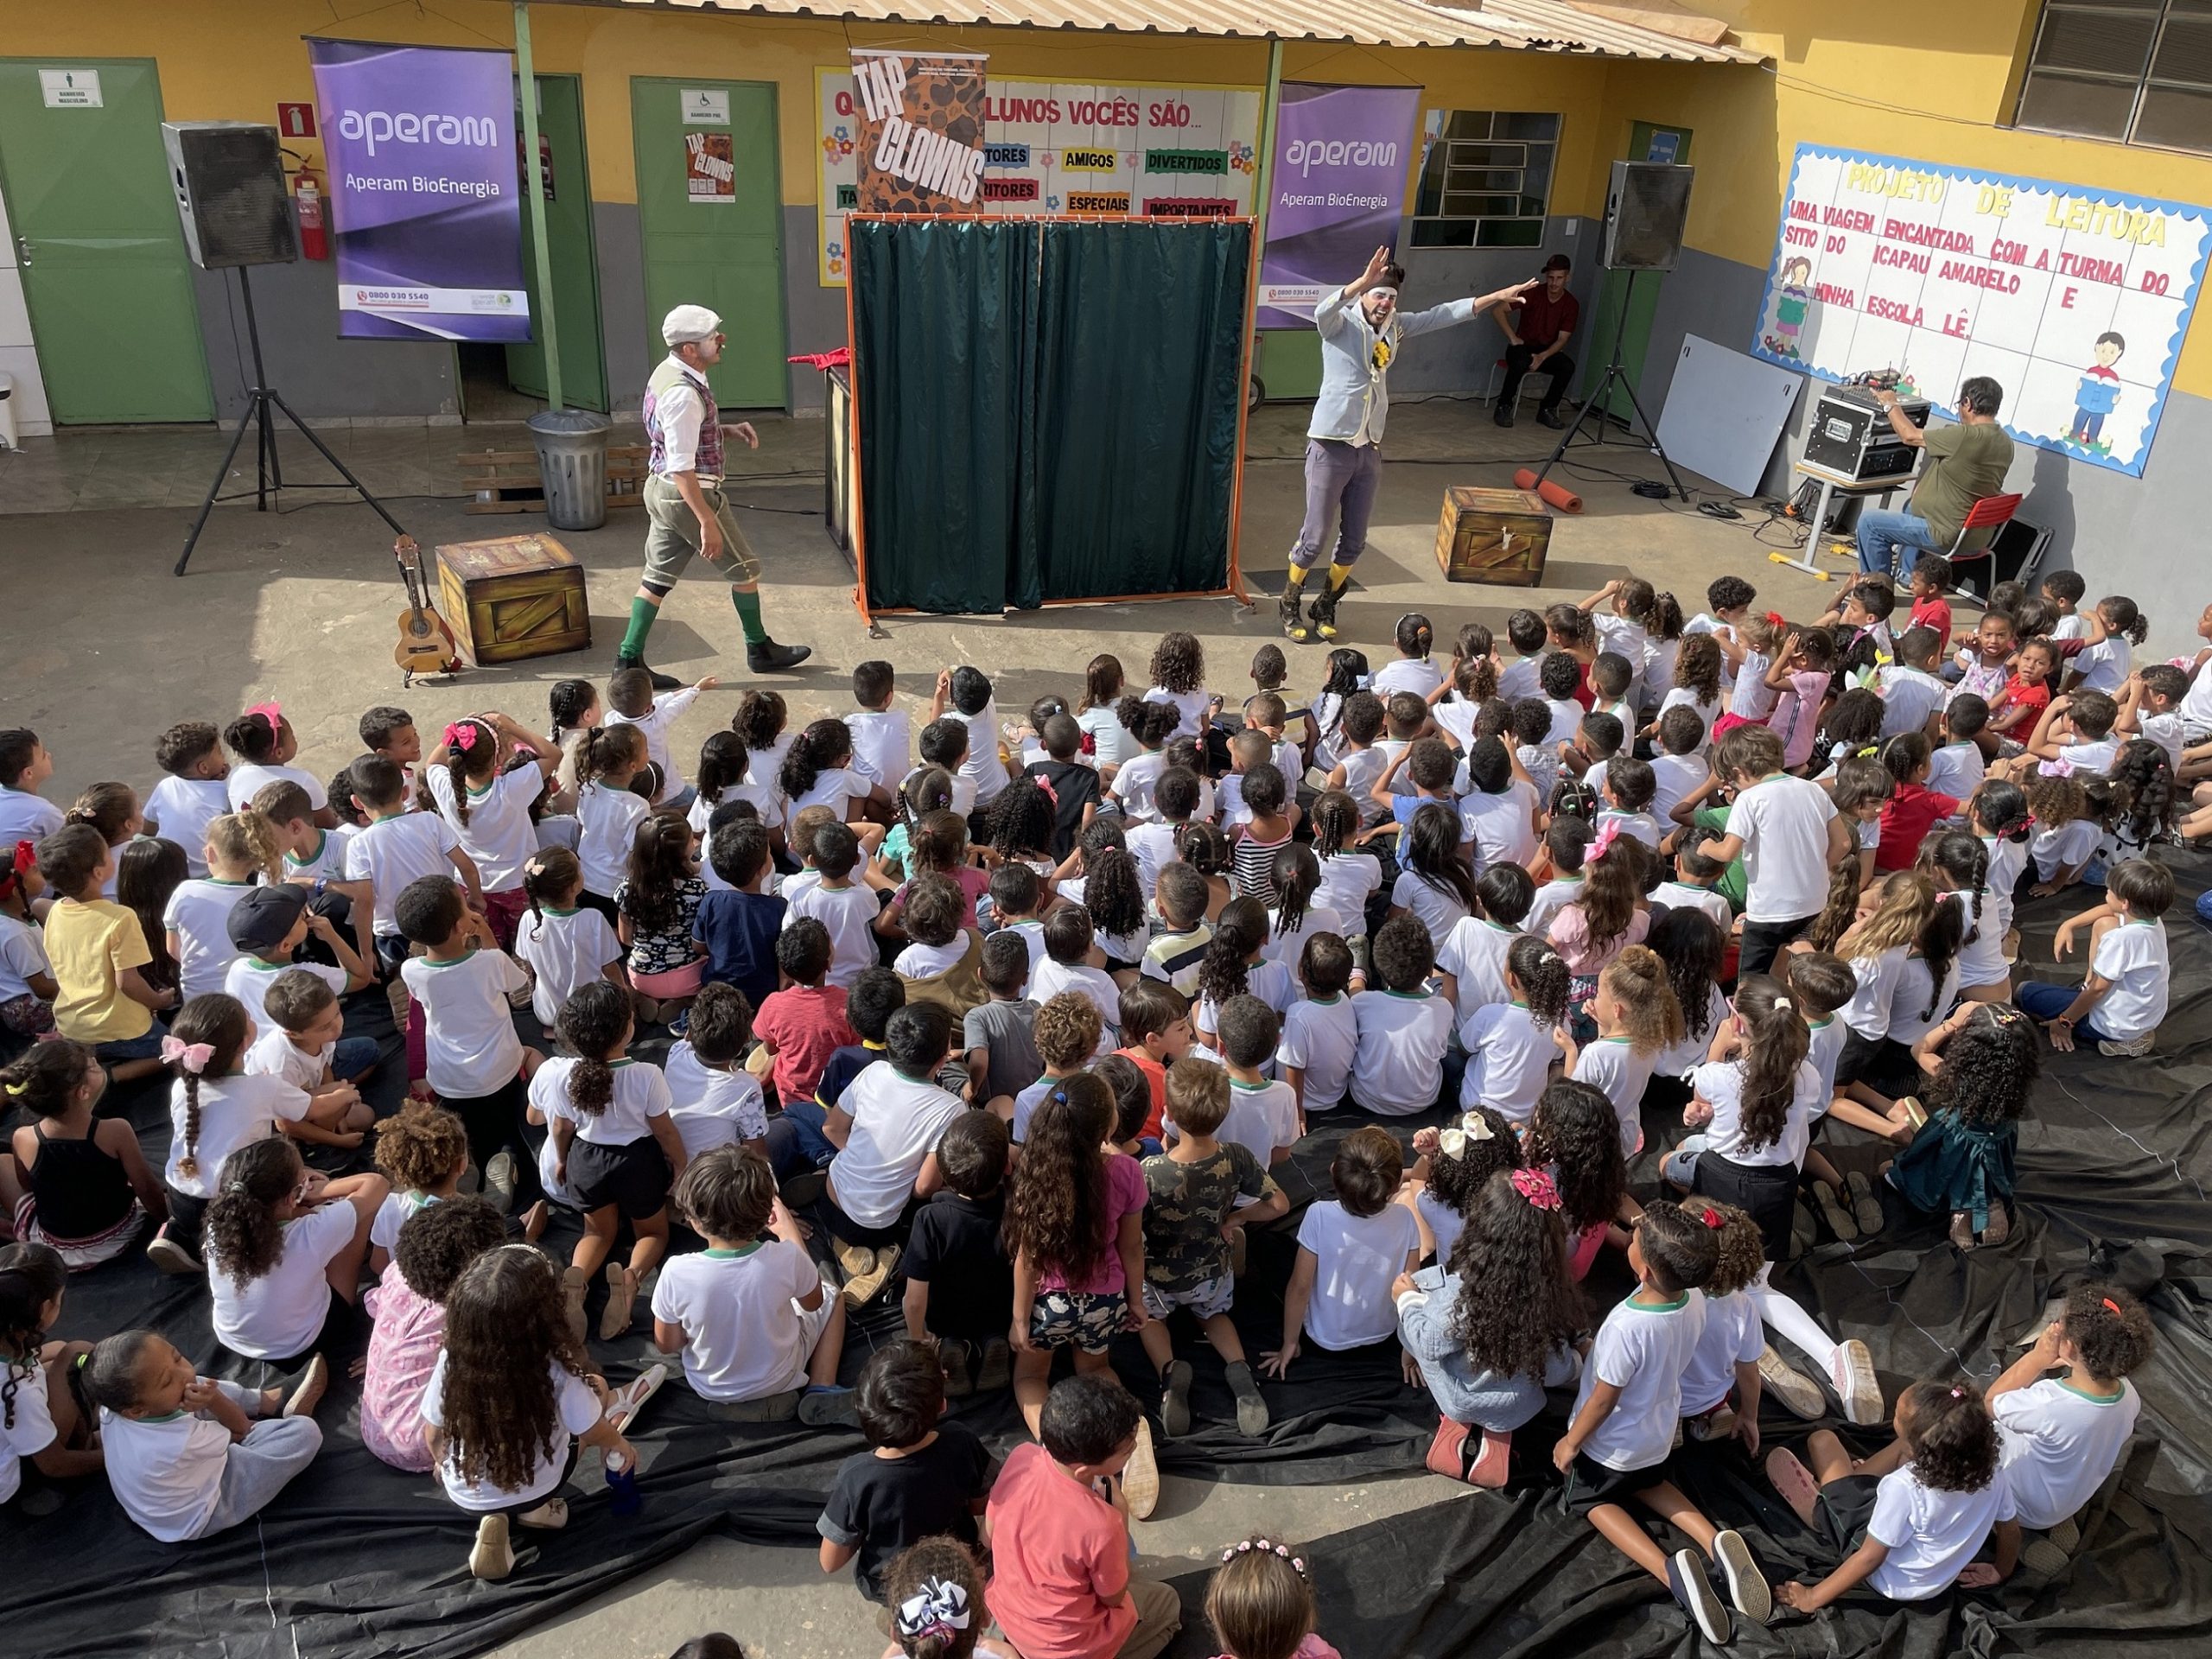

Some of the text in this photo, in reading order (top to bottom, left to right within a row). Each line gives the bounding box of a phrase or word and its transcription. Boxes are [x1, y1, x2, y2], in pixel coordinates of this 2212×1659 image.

[851, 56, 906, 122] TAP
[985, 97, 1061, 124] LUNOS
[1067, 96, 1140, 127] VOCÊS
[1148, 99, 1202, 128] SÃO...
[339, 109, 498, 156] aperam
[685, 132, 705, 155] TAP
[694, 151, 734, 182] CLOWNS
[874, 116, 985, 204] CLOWNS
[985, 149, 1027, 162] TORES
[1065, 152, 1115, 168] AMIGOS
[1148, 154, 1222, 170] DIVERTIDOS
[1286, 139, 1397, 178] aperam
[346, 173, 499, 198] Aperam BioEnergia
[1280, 192, 1388, 210] Aperam BioEnergia
[1069, 197, 1129, 212] ESPECIAIS
[1150, 203, 1231, 216] IMPORTANTES
[1847, 163, 2166, 247] PROJETO DE LEITURA
[1789, 200, 2170, 296] UMA VIAGEM ENCANTADA COM A TURMA DO
[1785, 225, 2079, 308] SITIO DO ICAPAU AMARELO E
[1814, 282, 1854, 308] MINHA
[1866, 296, 1924, 327] ESCOLA
